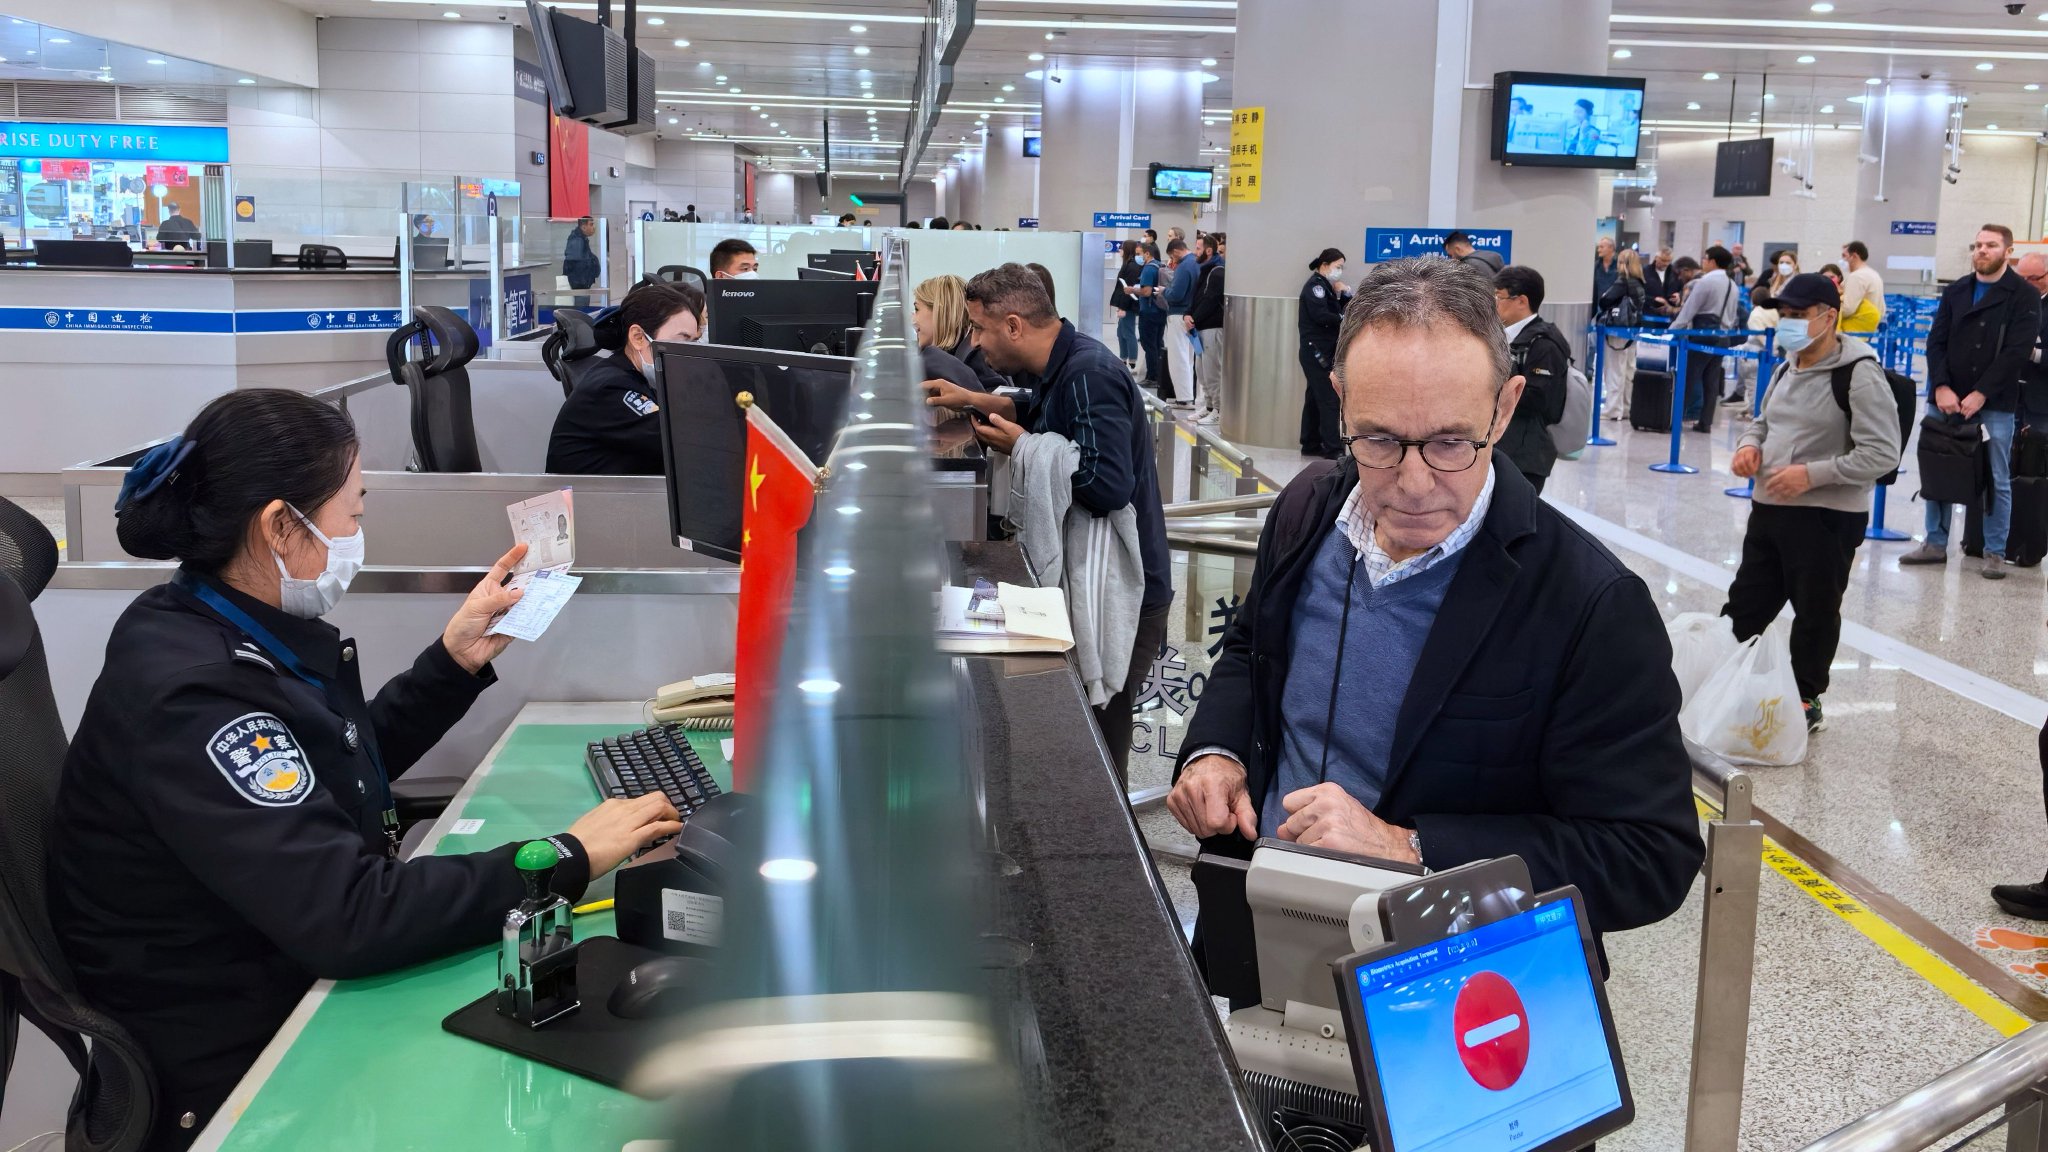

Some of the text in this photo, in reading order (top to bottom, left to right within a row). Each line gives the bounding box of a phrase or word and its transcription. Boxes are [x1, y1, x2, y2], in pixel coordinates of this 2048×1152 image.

[0, 133, 159, 150] RISE DUTY FREE
[1409, 233, 1501, 247] Arriv Card
[721, 289, 755, 297] lenovo
[1133, 646, 1189, 716] 关
[256, 751, 285, 767] POLICE
[1419, 947, 1439, 961] Terminal
